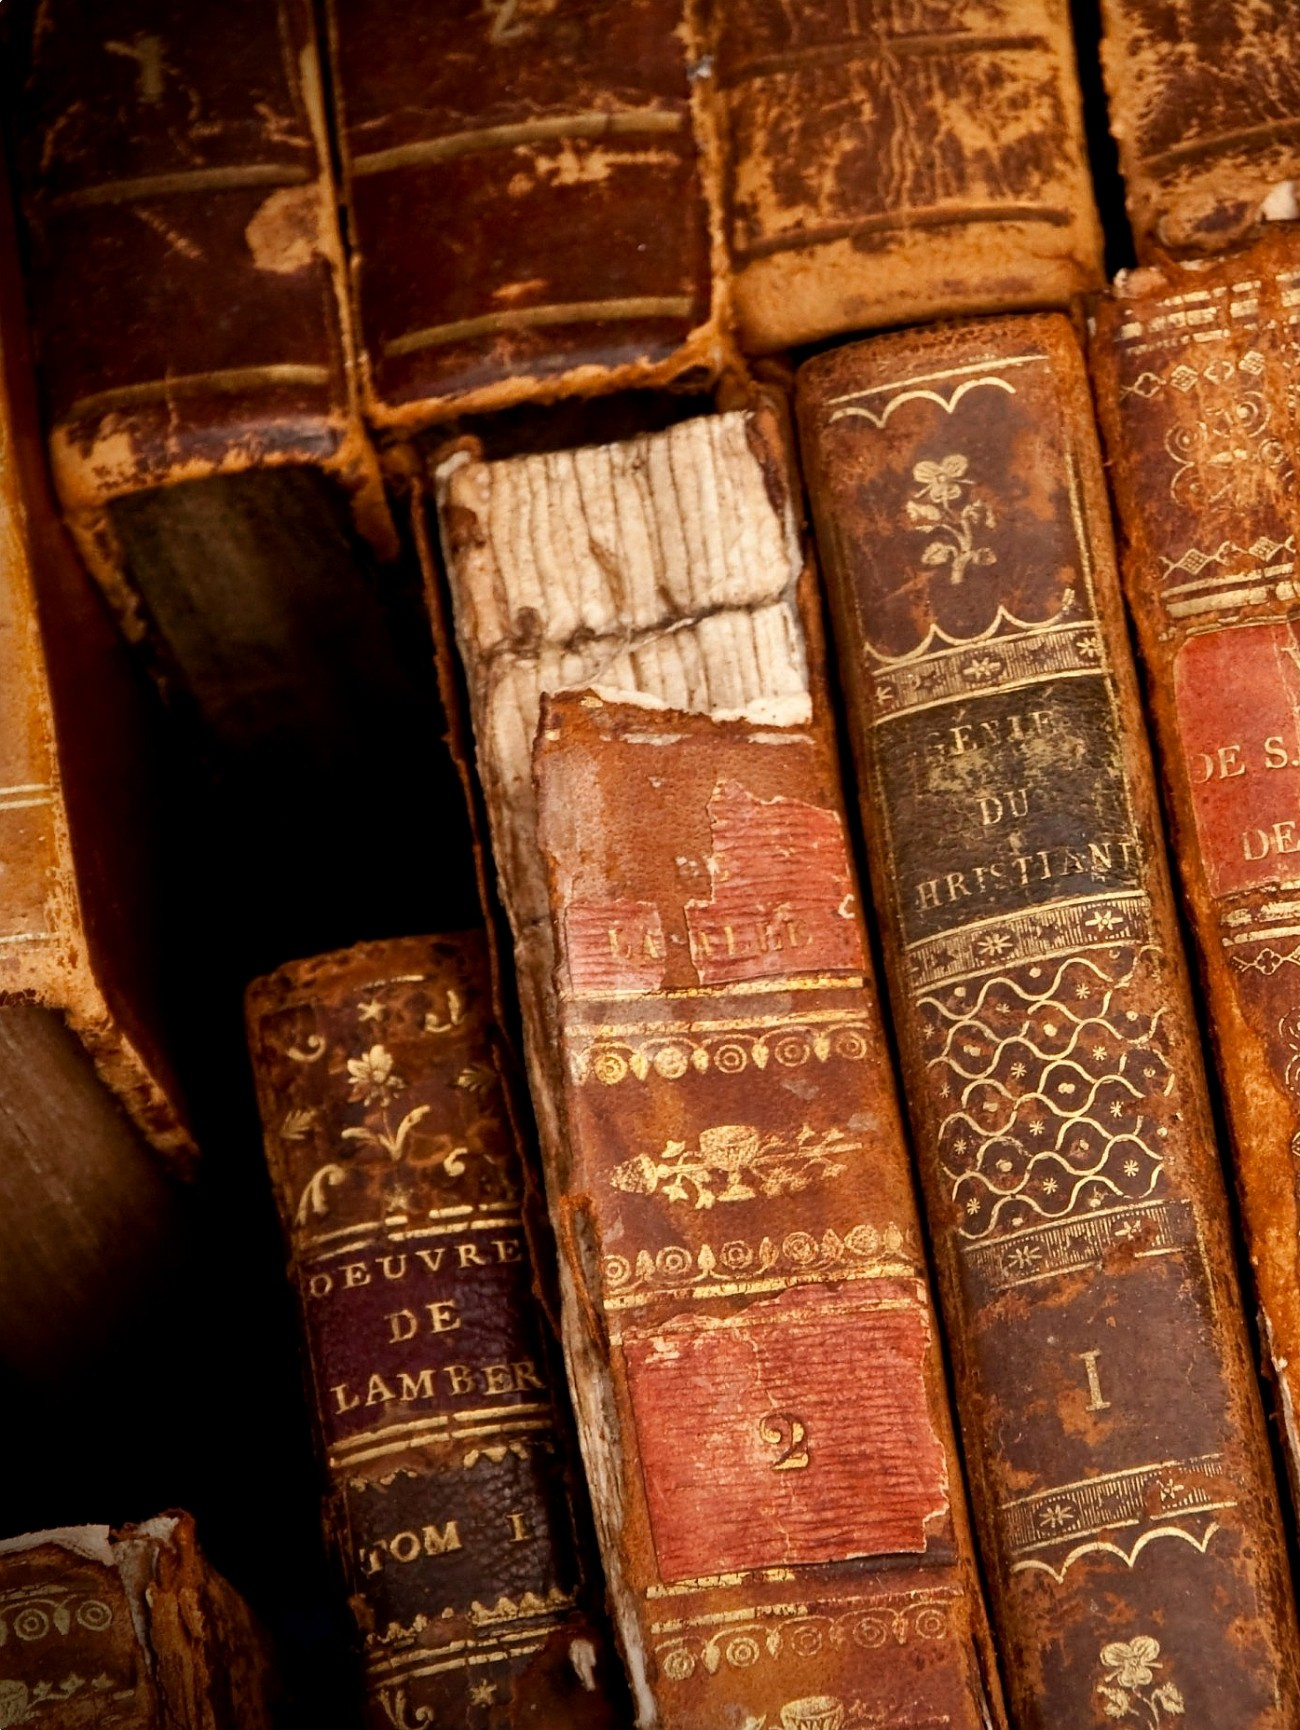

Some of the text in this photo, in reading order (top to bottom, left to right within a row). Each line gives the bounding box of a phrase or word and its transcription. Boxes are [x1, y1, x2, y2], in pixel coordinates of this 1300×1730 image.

[1263, 736, 1300, 770] S.
[979, 788, 1030, 826] DU
[308, 1238, 523, 1299] OEUVRE
[385, 1299, 461, 1343] DE
[330, 1359, 546, 1415] LAMBER
[759, 1412, 809, 1472] 2
[359, 1512, 532, 1576] TOM I
